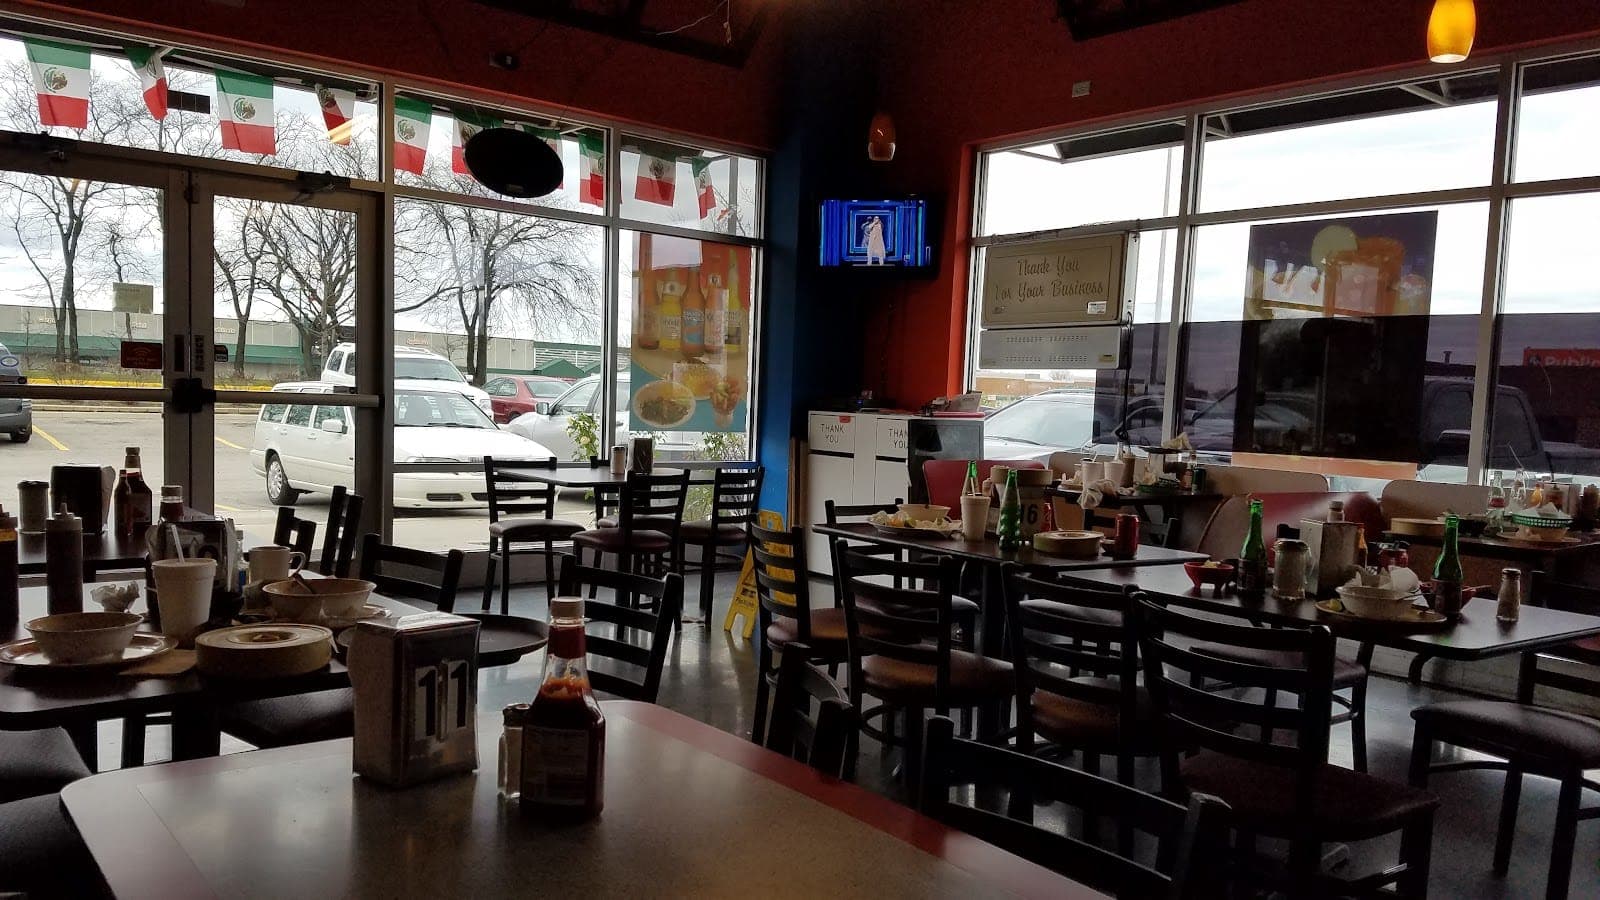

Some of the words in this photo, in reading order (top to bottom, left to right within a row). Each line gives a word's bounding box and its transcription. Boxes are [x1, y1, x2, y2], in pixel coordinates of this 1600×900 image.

[1017, 256, 1050, 276] Thank
[1056, 255, 1080, 280] You
[1018, 282, 1044, 303] Your
[1050, 279, 1104, 298] Business
[820, 423, 845, 434] THANK
[824, 434, 840, 444] YOU
[888, 428, 908, 439] THAN
[1027, 503, 1038, 525] 6
[416, 661, 468, 737] 11
